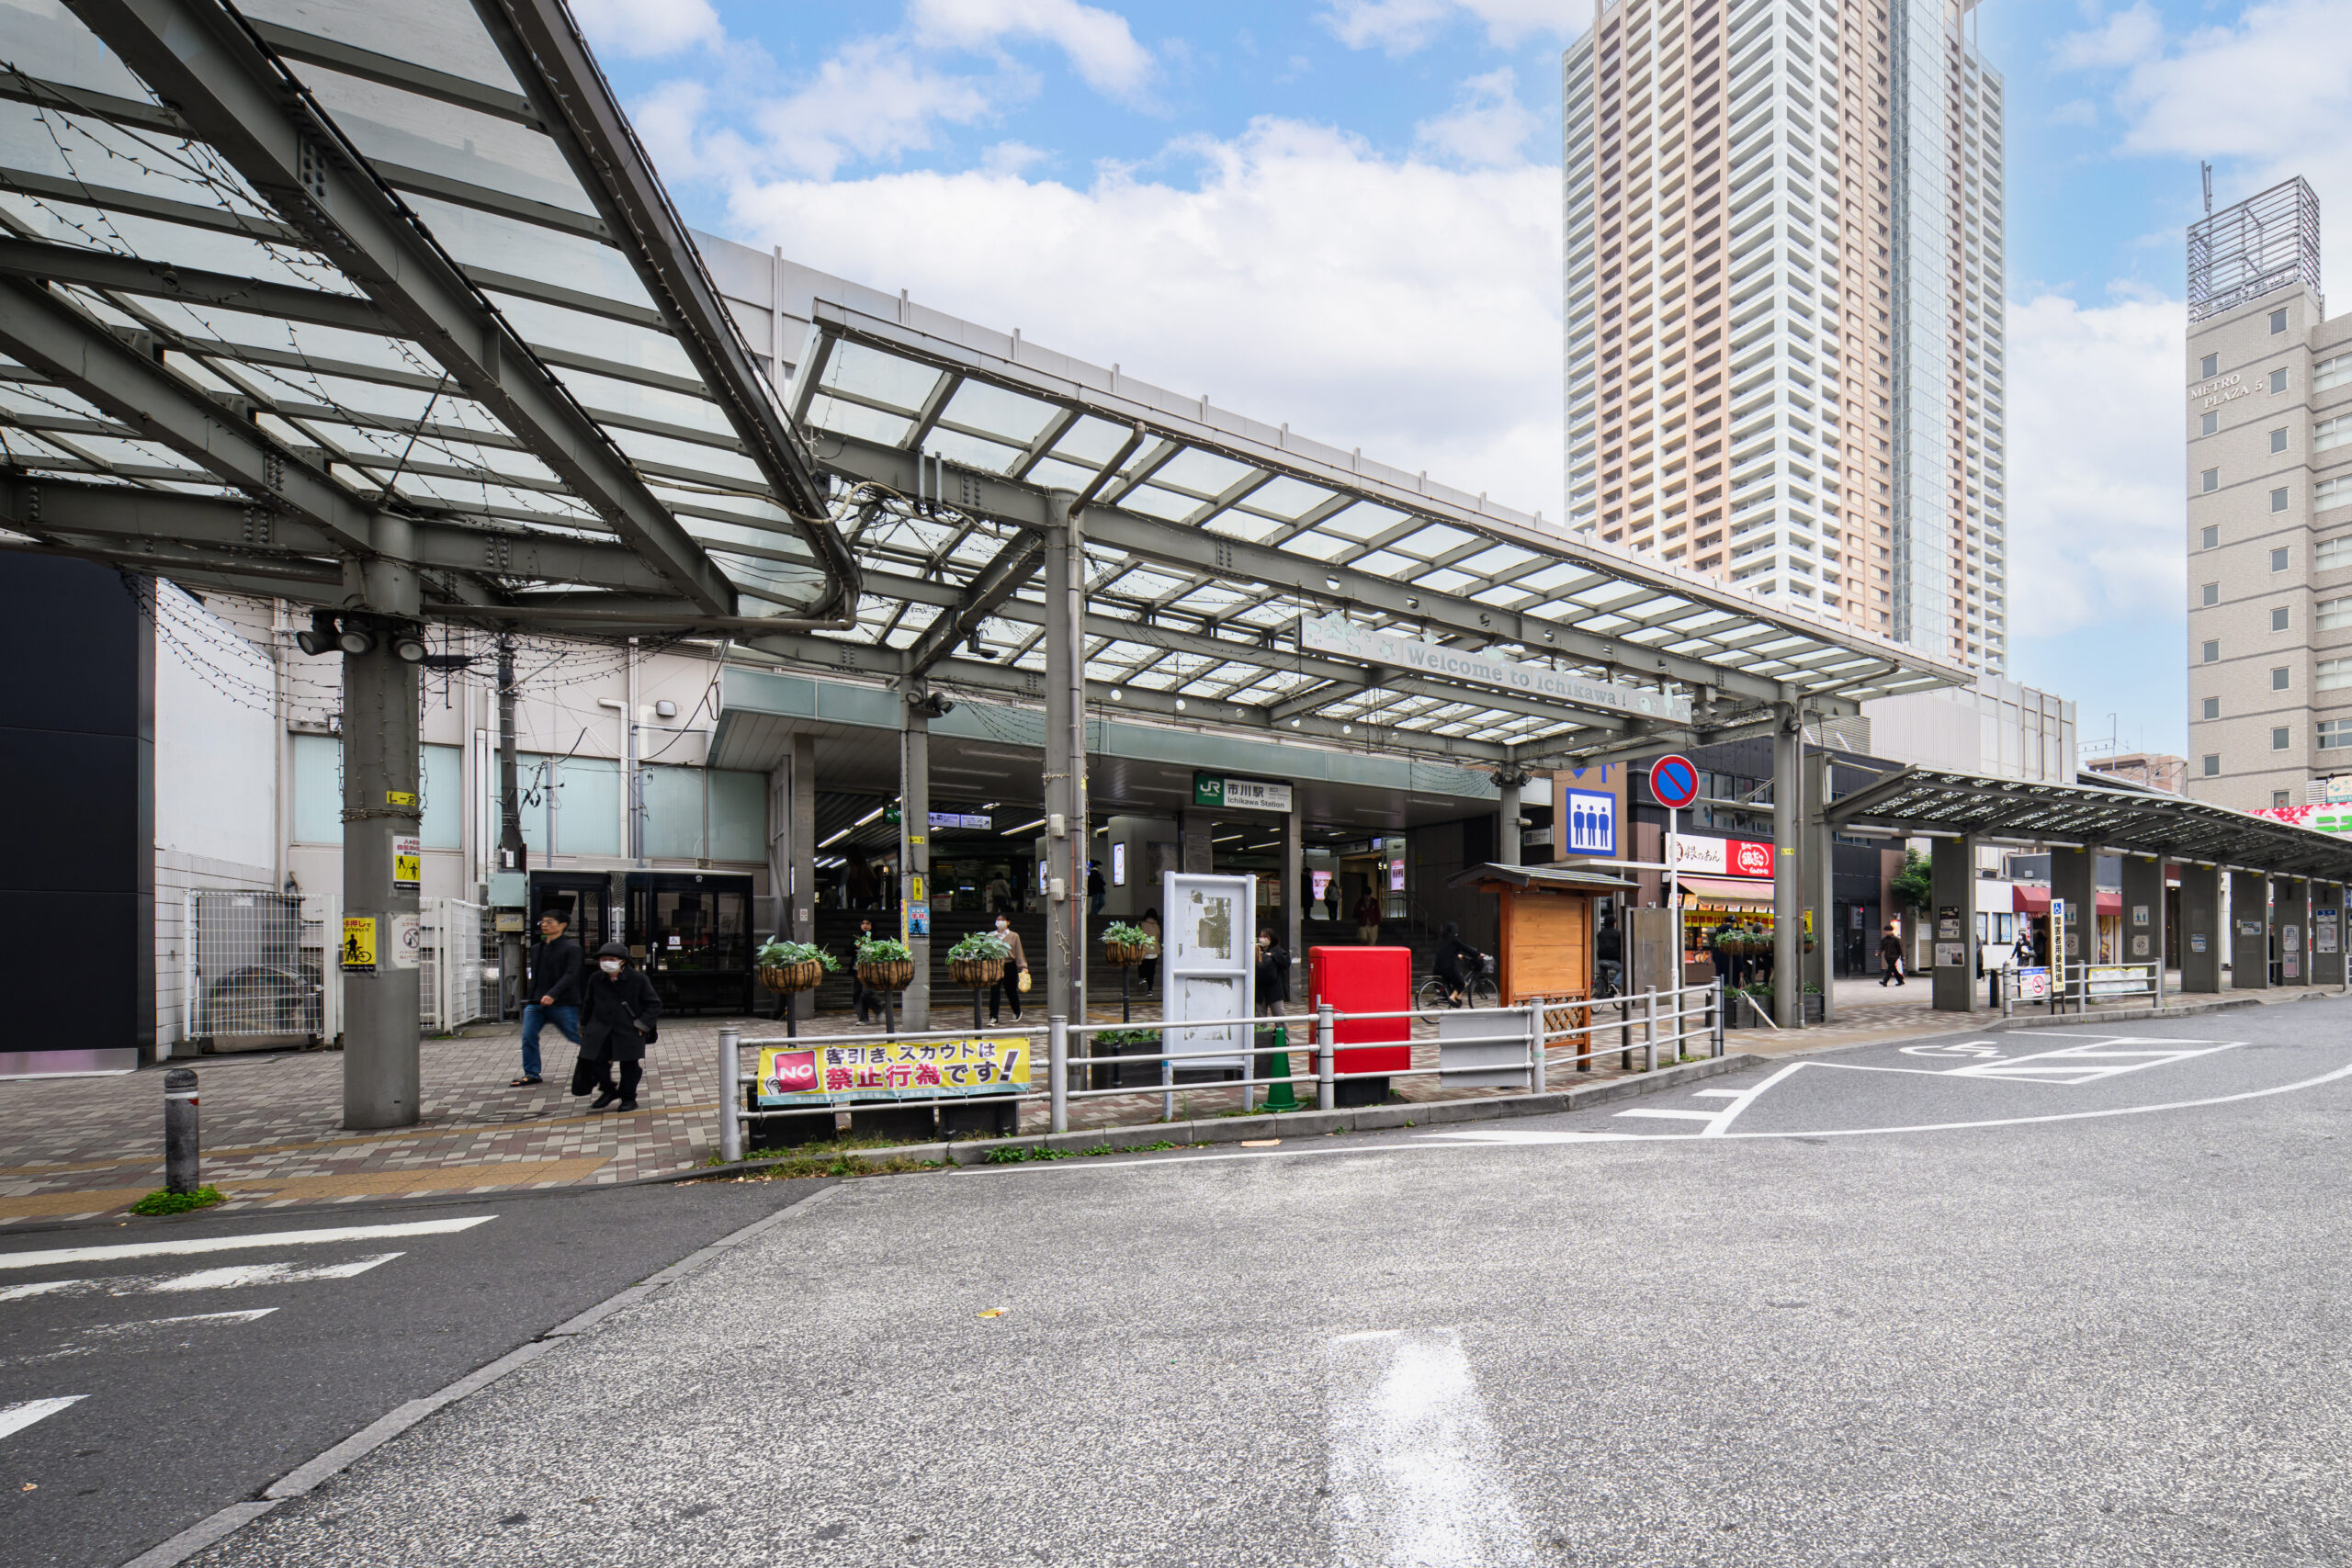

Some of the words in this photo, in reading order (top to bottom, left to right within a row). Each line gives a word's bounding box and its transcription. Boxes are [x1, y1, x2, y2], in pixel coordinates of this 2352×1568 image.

[2190, 374, 2241, 400] METRO
[2204, 385, 2250, 409] PLAZA
[2255, 379, 2264, 391] 5
[1407, 646, 1503, 682] Welcome
[1510, 669, 1531, 687] to
[1536, 671, 1617, 705] Ichikawa
[1200, 781, 1221, 794] JR
[1227, 784, 1264, 797] 市川駅
[1227, 796, 1259, 806] Ichikawa
[1260, 799, 1285, 808] Station
[1684, 845, 1721, 863] 銀のあん
[826, 1043, 996, 1065] 客引き、スカウトは
[779, 1064, 814, 1079] NO
